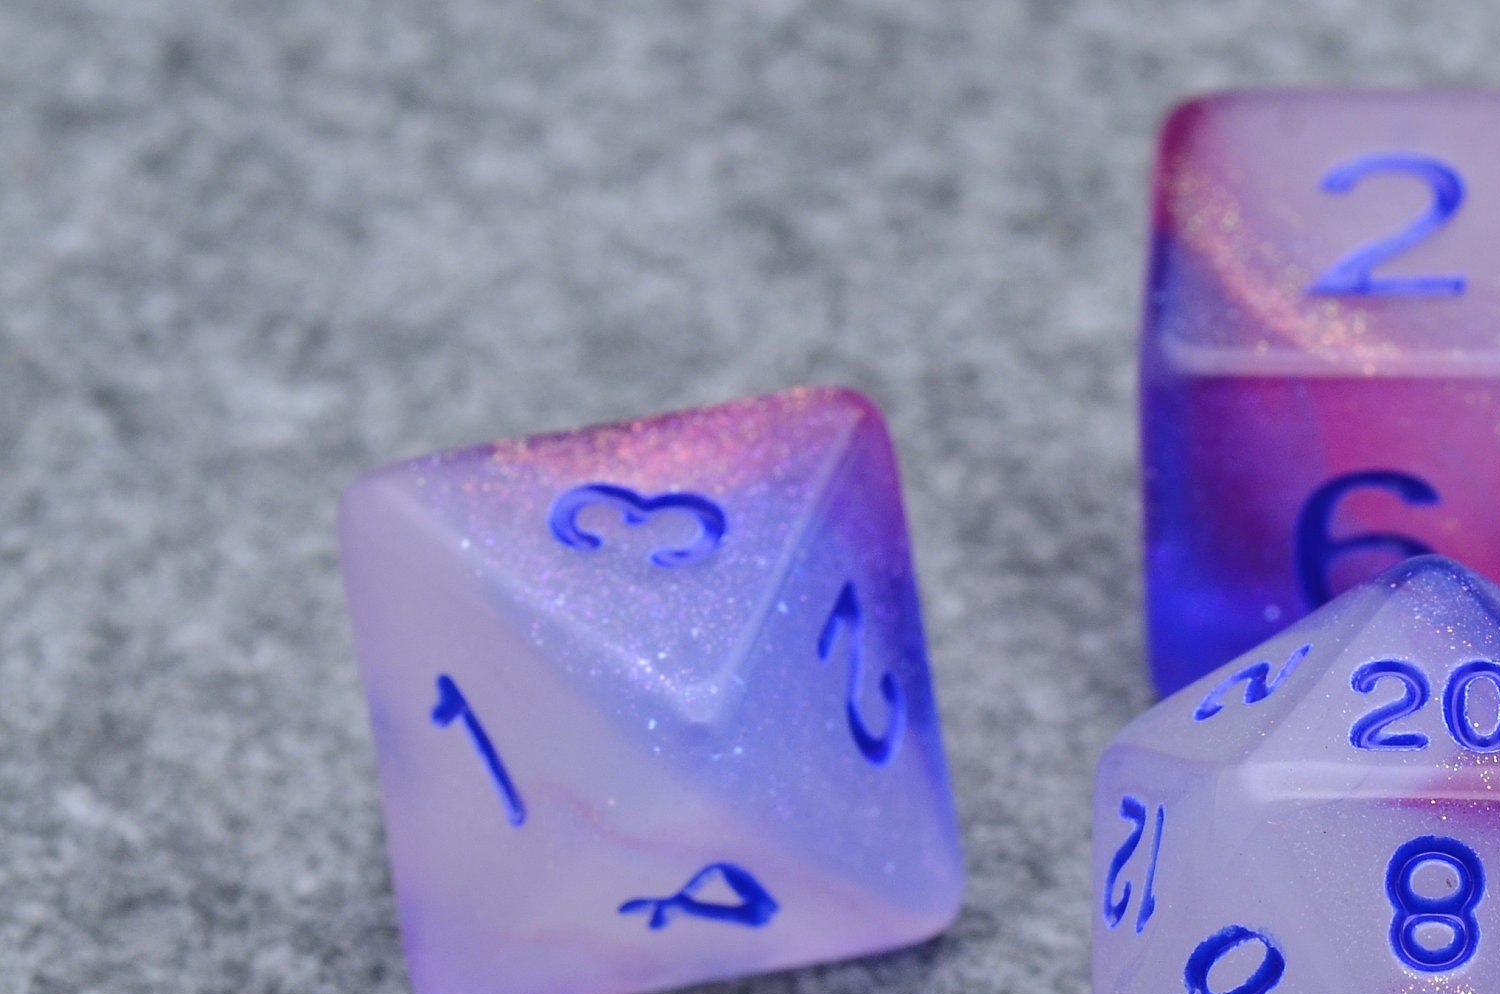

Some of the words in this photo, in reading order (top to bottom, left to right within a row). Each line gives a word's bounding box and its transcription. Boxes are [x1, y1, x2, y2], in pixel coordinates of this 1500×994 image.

[1310, 150, 1468, 297] 2
[547, 483, 727, 567] 3
[817, 580, 905, 766] 2
[1192, 644, 1312, 721] 2
[430, 674, 527, 826] 1
[618, 863, 778, 929] 4
[1104, 794, 1165, 934] 12
[1385, 834, 1487, 973] 8
